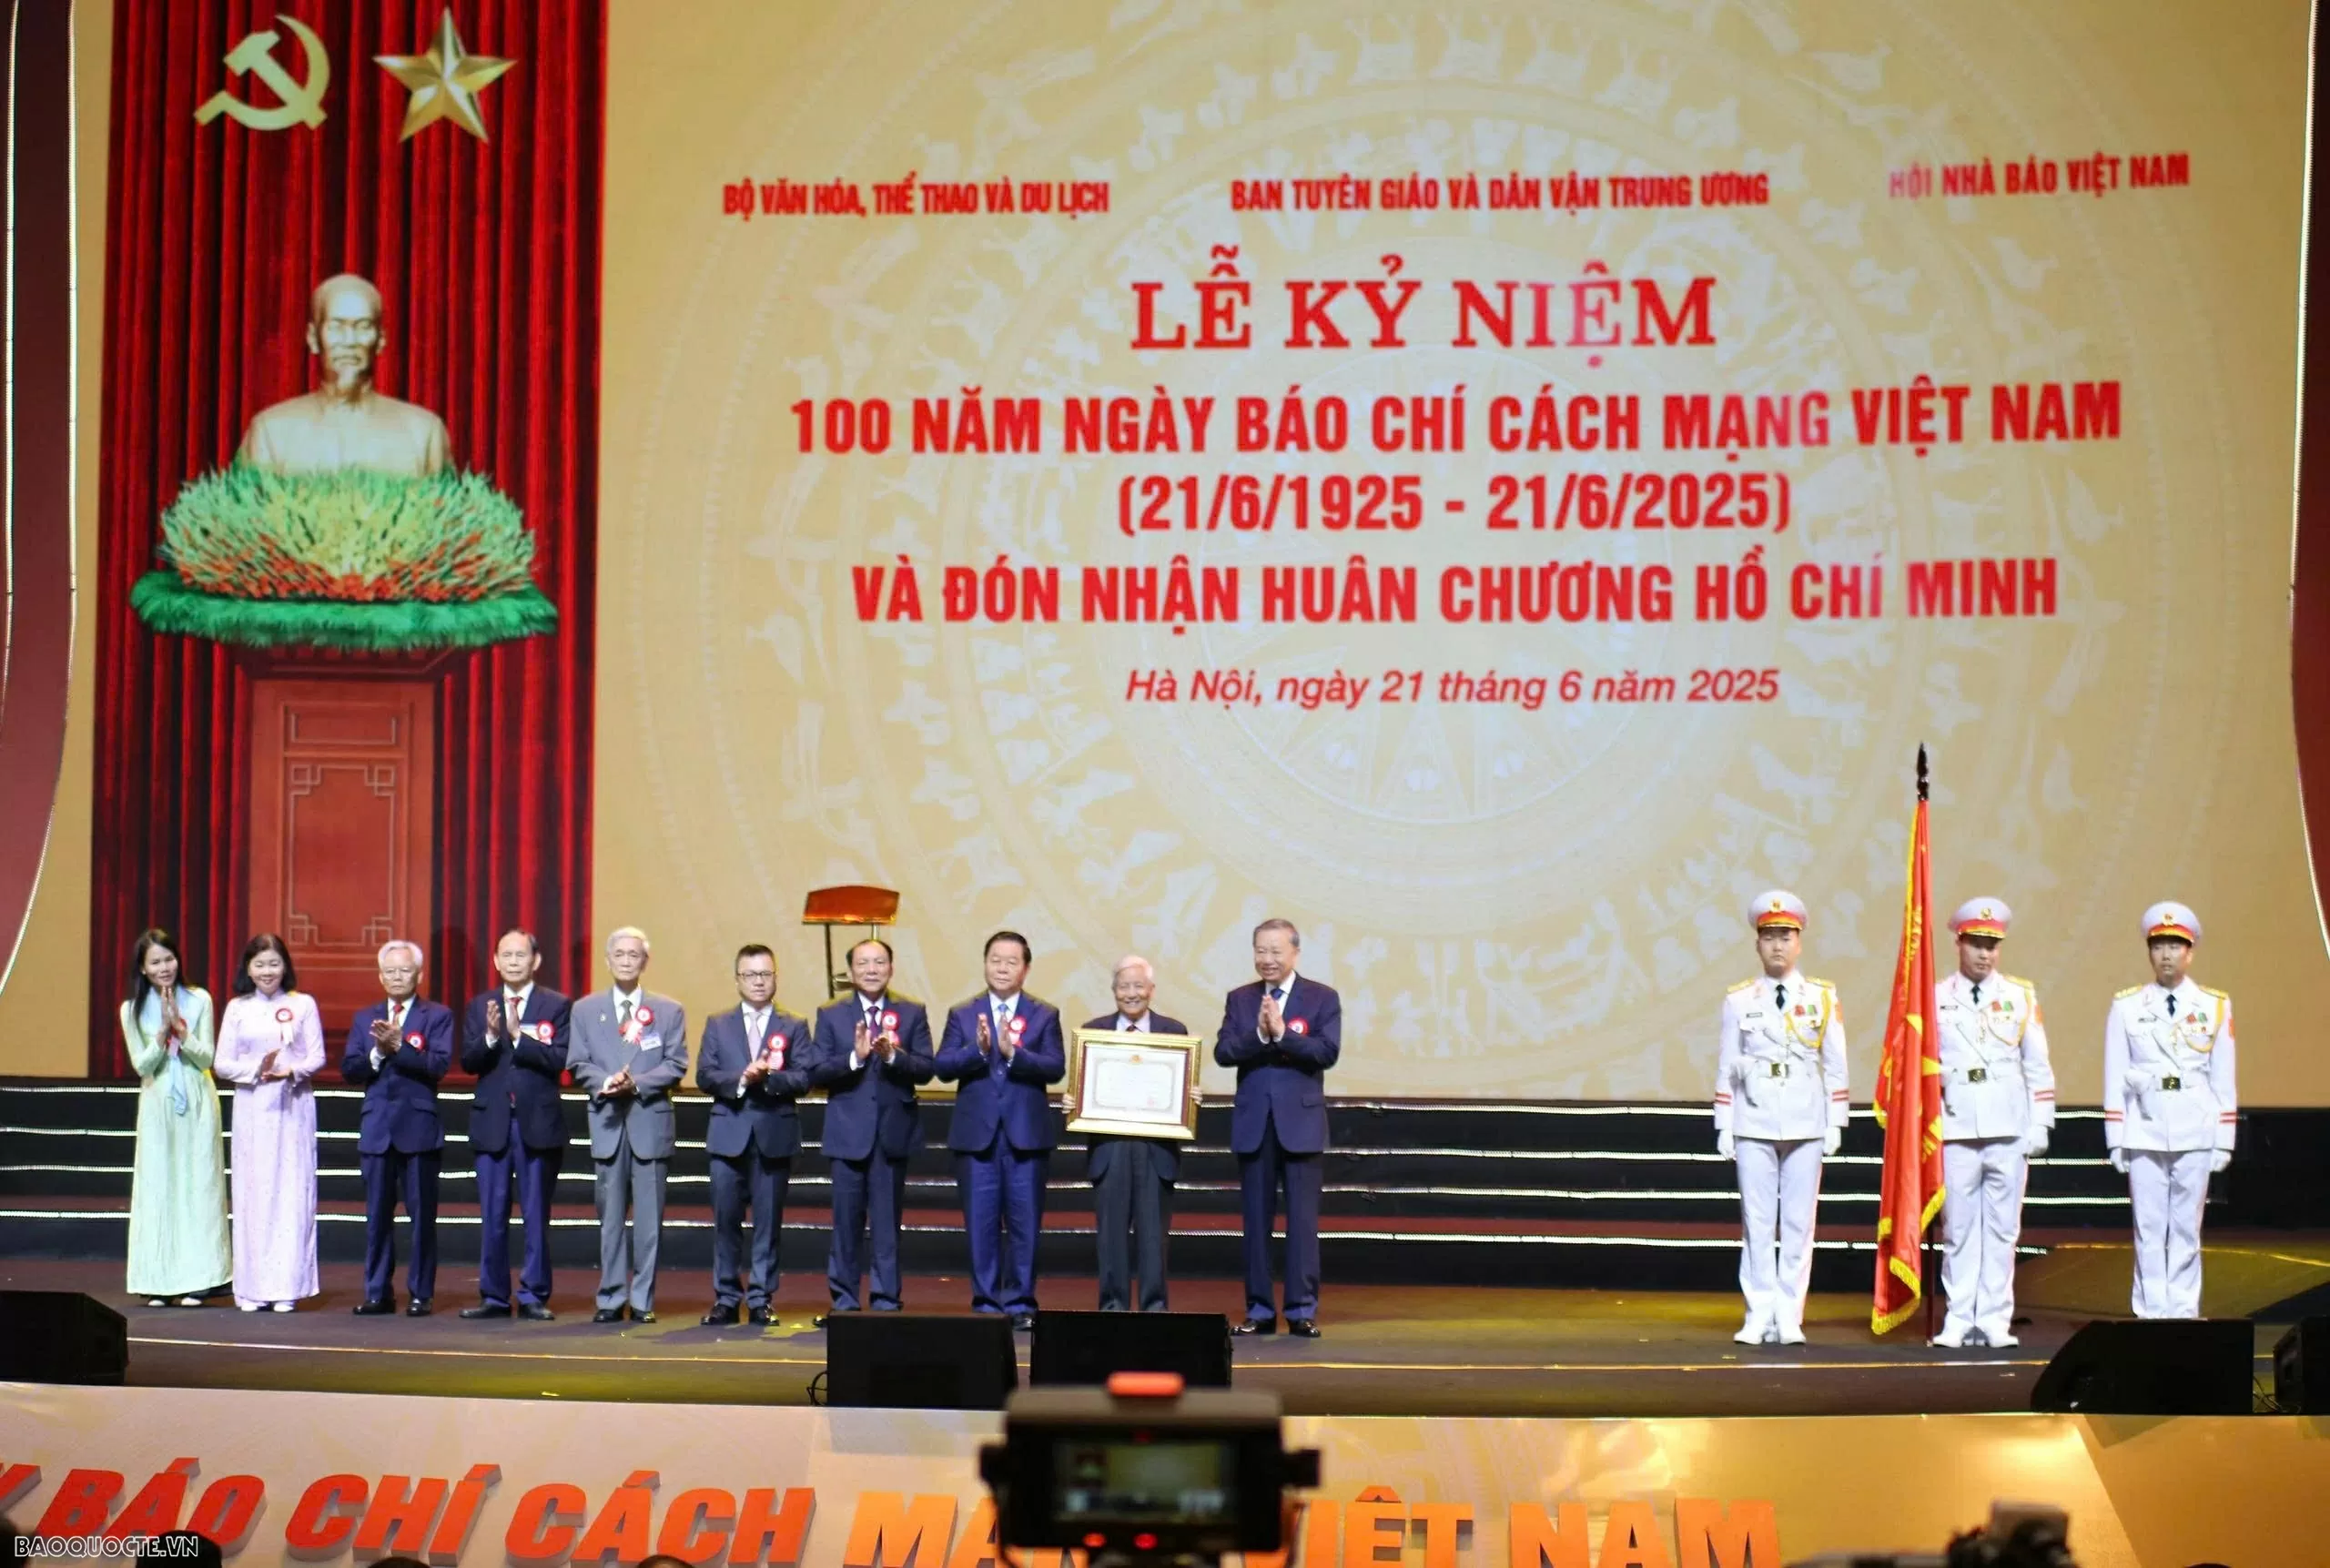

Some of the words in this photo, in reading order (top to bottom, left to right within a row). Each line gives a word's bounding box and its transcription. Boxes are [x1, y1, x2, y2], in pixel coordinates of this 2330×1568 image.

[722, 177, 755, 222] BỘ
[760, 177, 807, 216] VĂN
[920, 182, 978, 215] THAO
[984, 175, 1015, 214] VÀ
[1019, 181, 1052, 214] DU
[1057, 181, 1109, 220] LỊCH
[1231, 179, 1284, 211] BAN
[1292, 173, 1373, 211] TUYÊN
[1380, 173, 1440, 211] GIÁO
[1447, 174, 1481, 210] VÀ
[1488, 172, 1542, 210] DÂN
[1549, 170, 1601, 216] VẬN
[1607, 175, 1693, 208] TRUNG
[1699, 170, 1770, 208] ƯƠNG
[1941, 157, 1997, 196] NHÀ
[2004, 154, 2059, 196] BÁO
[2065, 151, 2122, 197] VIỆT
[2128, 151, 2192, 188] NAM
[1130, 244, 1252, 350] LỄ
[1284, 254, 1422, 349] KỶ
[1452, 259, 1717, 368] NIỆM
[789, 397, 892, 456] 100
[911, 386, 1042, 455] NĂM
[1063, 384, 1215, 454] NGÀY
[1237, 384, 1349, 453] BÁO
[1372, 384, 1465, 452] CHÍ
[1488, 383, 1640, 452] CÁCH
[1663, 390, 1829, 461] MẠNG
[1850, 375, 1971, 458] VIỆT
[1991, 379, 2122, 442] NAM
[1119, 473, 1423, 539] (21/6/1925
[1445, 500, 1464, 513] -
[1487, 471, 1791, 533] 21/6/2025)
[851, 553, 925, 622] VÀ
[942, 553, 1059, 623] ĐÓN
[1081, 553, 1240, 636] NHẬN
[1261, 553, 1417, 623] HUÂN
[1440, 560, 1674, 623] CHƯƠNG
[1696, 544, 1768, 622] HỒ
[1790, 551, 1883, 620] CHÍ
[1907, 558, 2058, 618] MINH
[1126, 670, 1178, 702] Hà
[1190, 670, 1261, 710] Nội,
[1278, 671, 1369, 710] ngày
[1380, 670, 1423, 702] 21
[1439, 670, 1547, 711] tháng
[1559, 670, 1582, 702] 6
[1594, 671, 1675, 702] năm
[1687, 669, 1778, 702] 2025
[35, 1457, 266, 1547] BÁO
[285, 1463, 501, 1558] CHÍ
[504, 1470, 816, 1567] CÁCH
[1509, 1498, 1781, 1568] NAM
